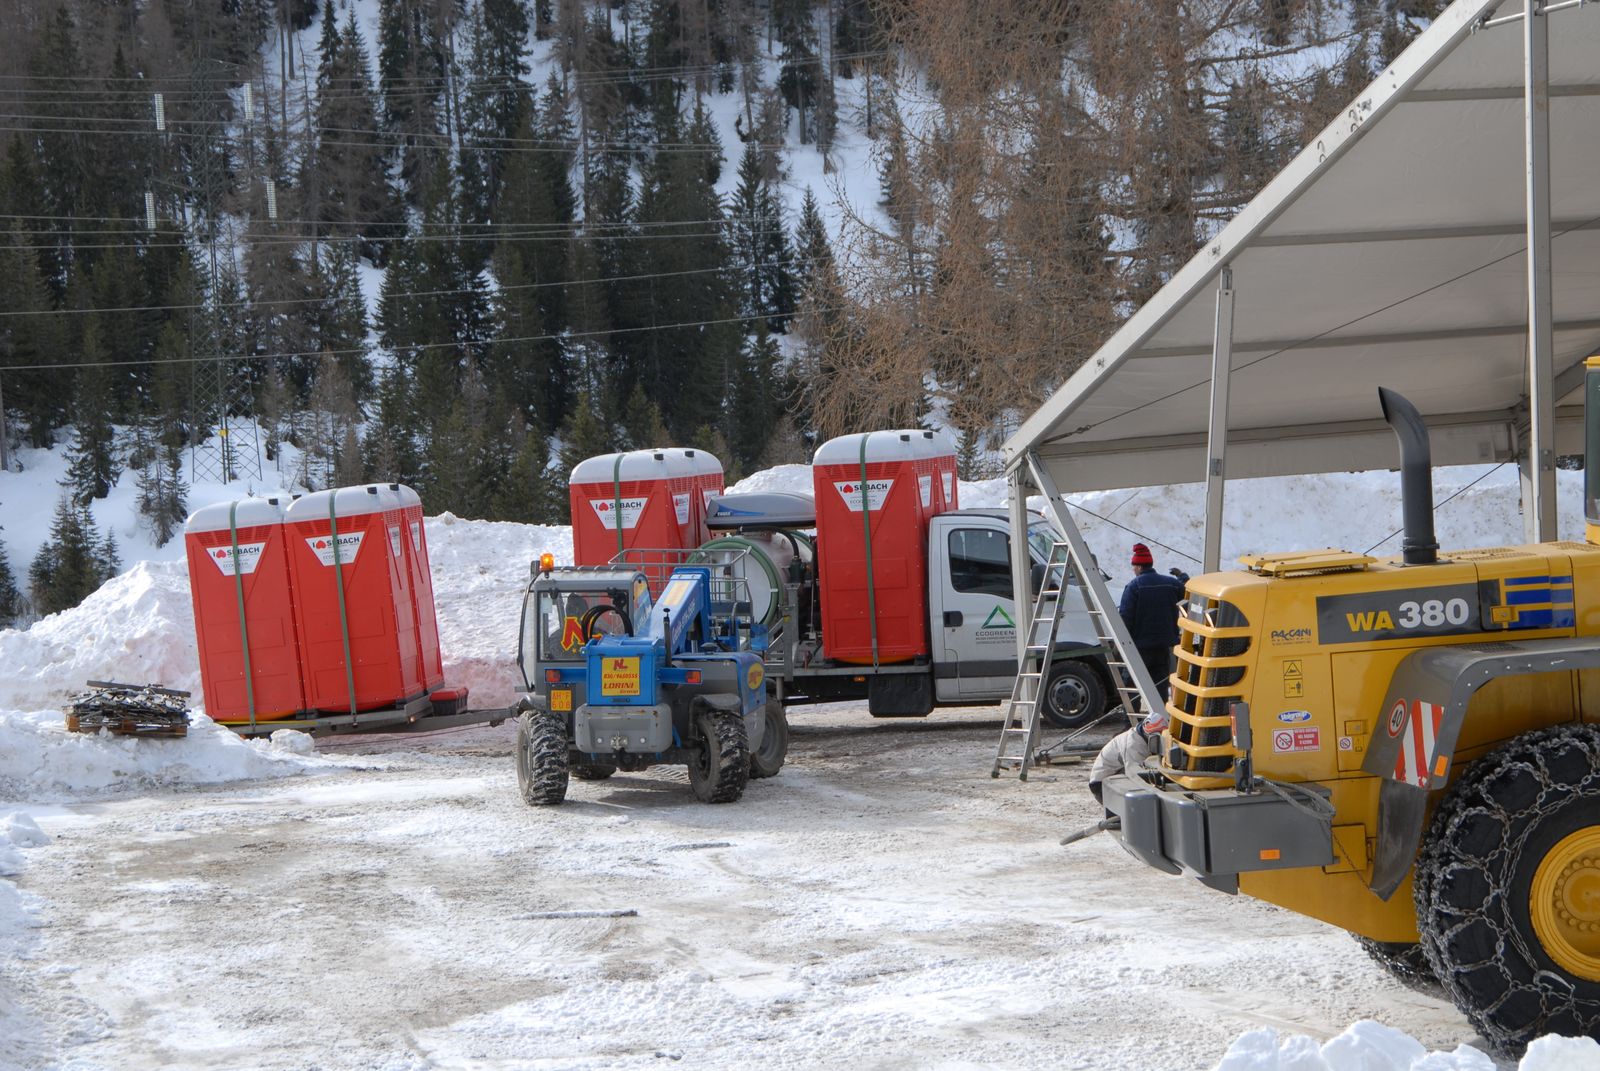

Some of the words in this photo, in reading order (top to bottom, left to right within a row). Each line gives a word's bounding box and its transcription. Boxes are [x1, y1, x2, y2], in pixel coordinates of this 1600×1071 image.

[326, 536, 360, 547] SBACH
[226, 546, 260, 556] SBACH
[1346, 610, 1396, 632] WA
[1399, 598, 1469, 629] 380
[603, 682, 634, 690] LORINI
[1392, 709, 1403, 727] 40
